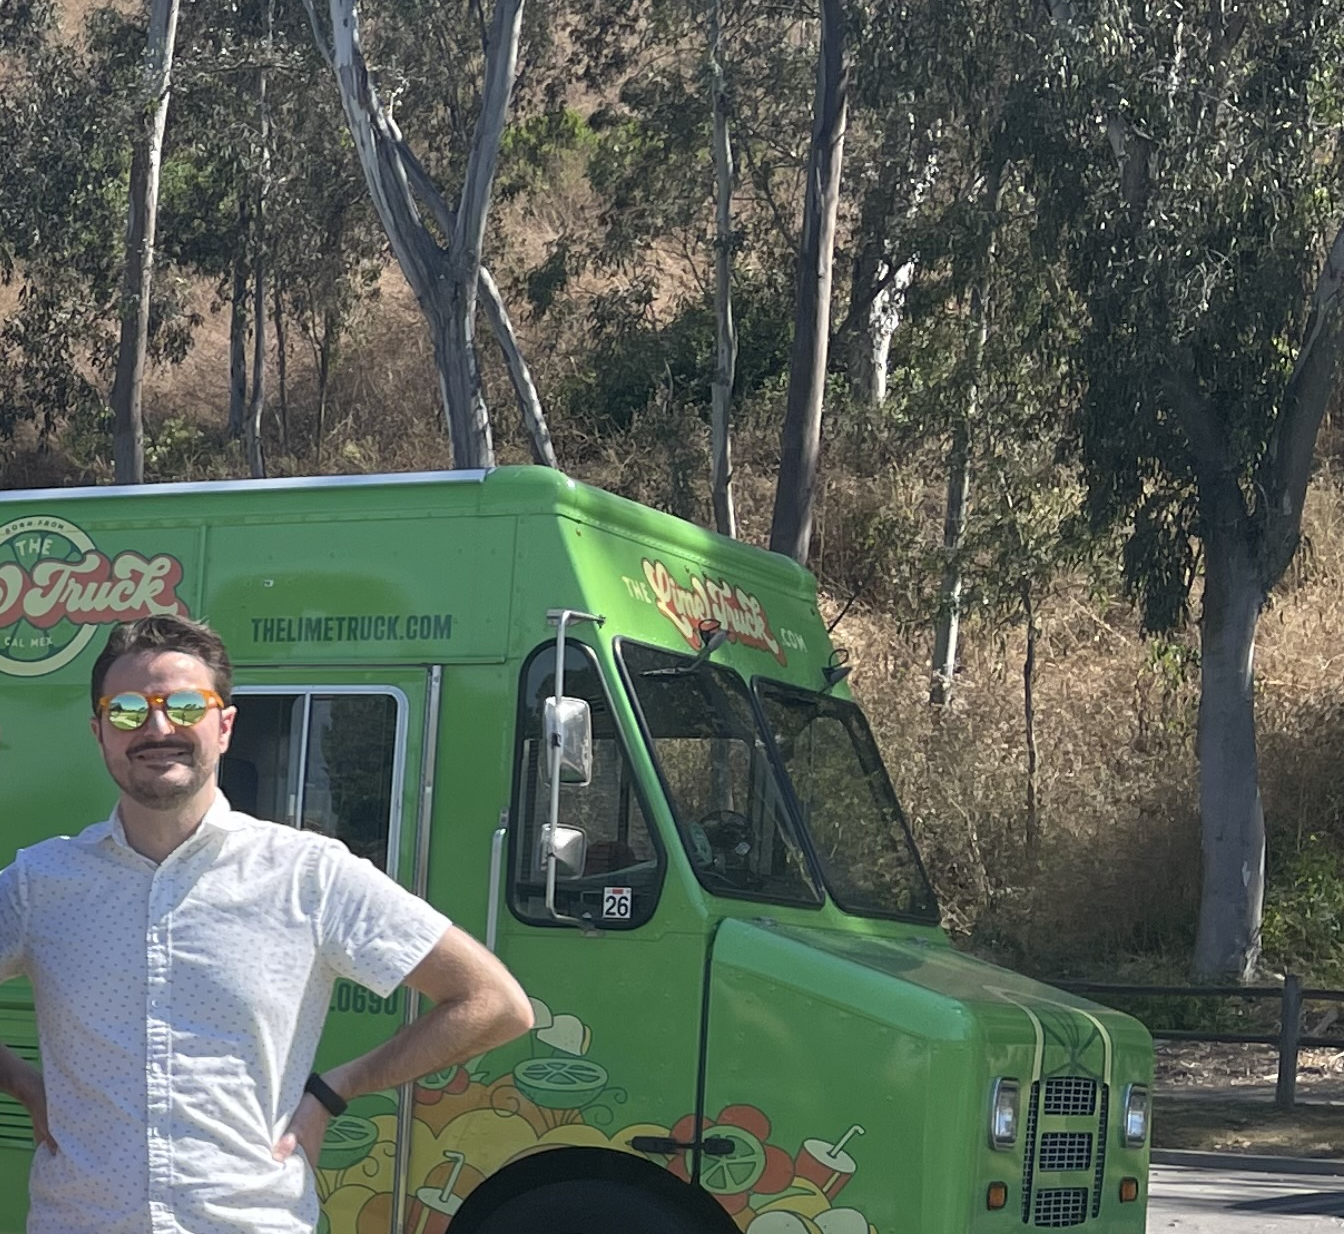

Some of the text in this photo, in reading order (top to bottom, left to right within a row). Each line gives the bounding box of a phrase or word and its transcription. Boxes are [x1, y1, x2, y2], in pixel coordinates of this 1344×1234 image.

[15, 538, 53, 556] THE
[23, 551, 179, 617] Truck
[622, 576, 652, 603] THE
[643, 559, 711, 639] Lime
[707, 580, 779, 654] Truck
[251, 614, 452, 643] THELIMETRUCK.COM
[4, 636, 54, 648] CAL MEX
[605, 895, 629, 917] 26
